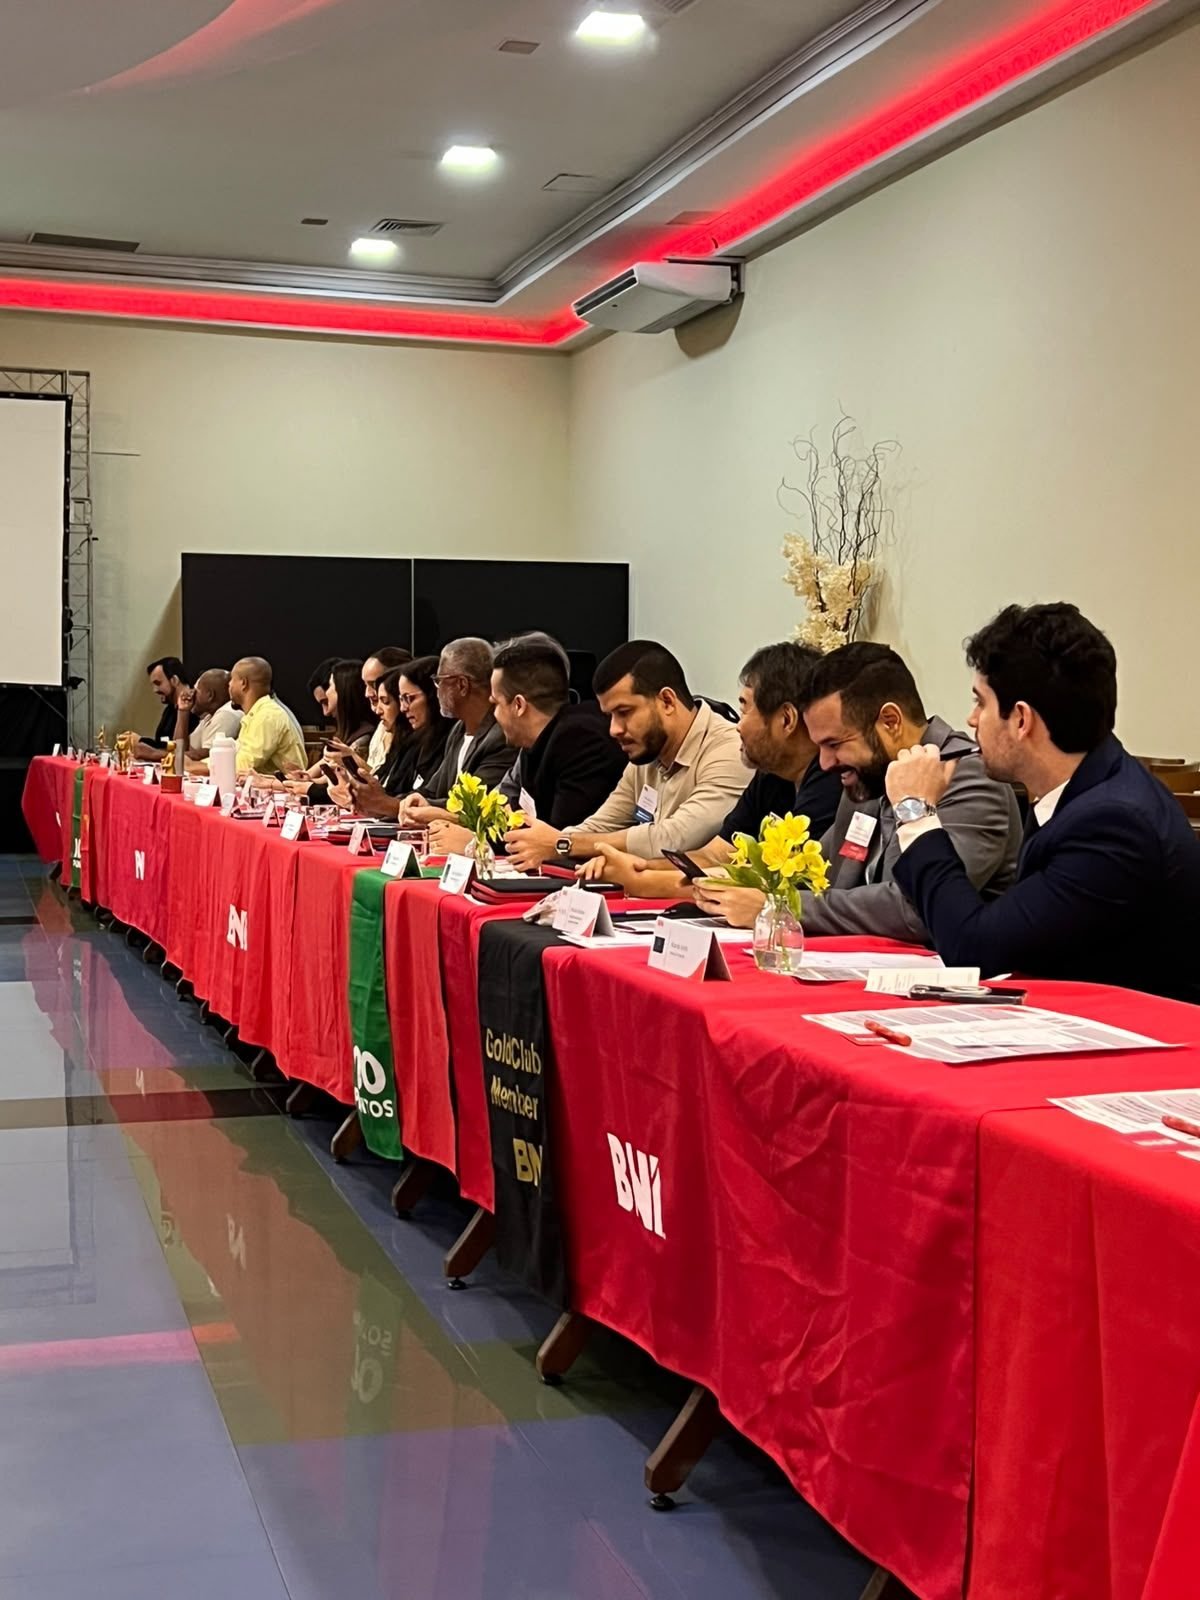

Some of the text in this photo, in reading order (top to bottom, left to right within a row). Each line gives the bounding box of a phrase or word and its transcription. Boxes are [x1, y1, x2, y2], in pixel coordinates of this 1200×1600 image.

[486, 1028, 542, 1075] GoldClub
[490, 1075, 539, 1120] Member
[513, 1138, 543, 1187] BN
